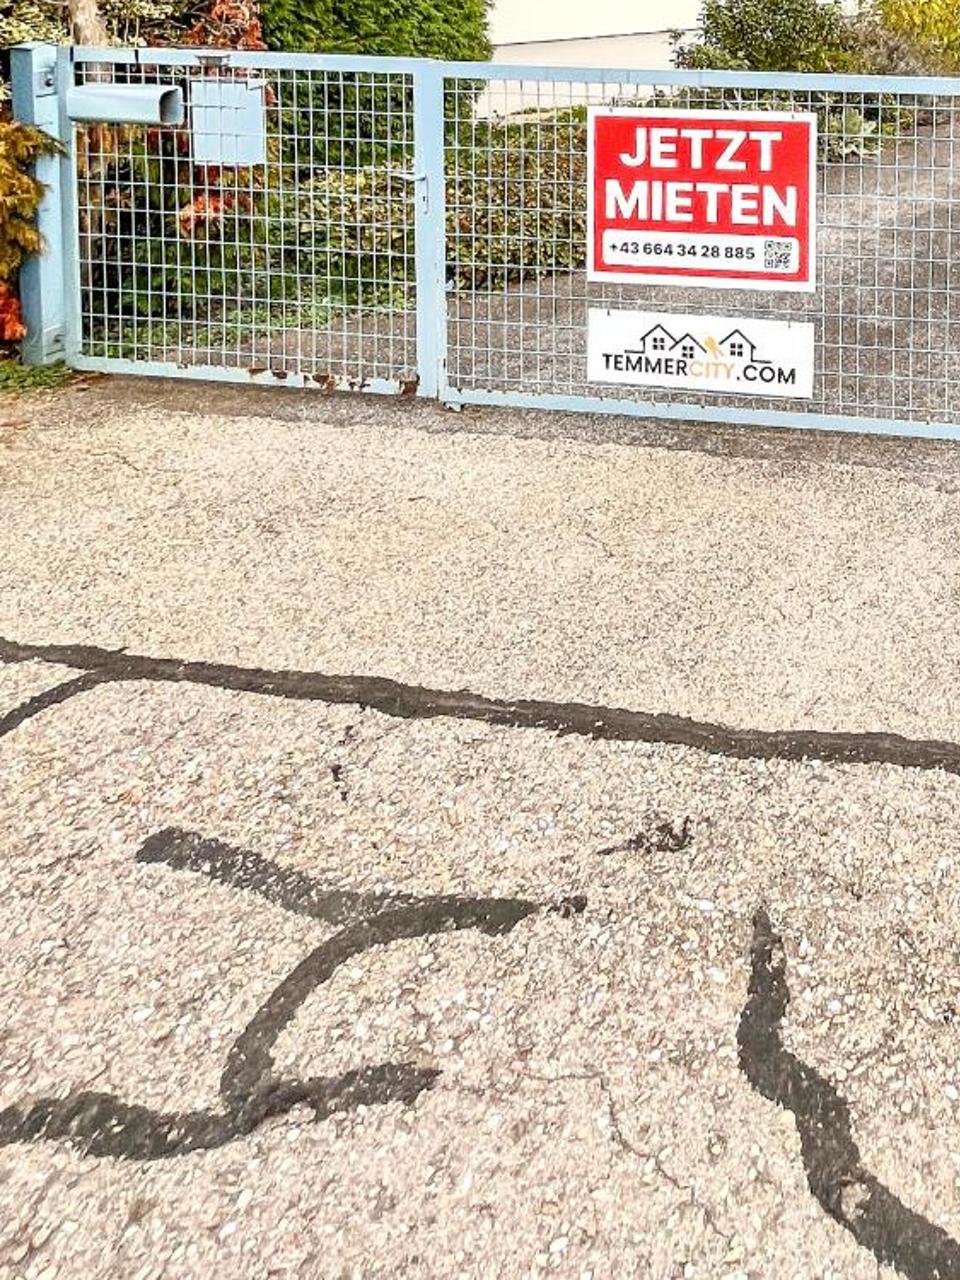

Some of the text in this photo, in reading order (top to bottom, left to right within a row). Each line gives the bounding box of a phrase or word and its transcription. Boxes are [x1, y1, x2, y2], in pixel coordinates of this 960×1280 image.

[619, 126, 782, 171] JETZT
[605, 180, 796, 226] MIETEN
[610, 242, 755, 260] +43 664 34 28 885
